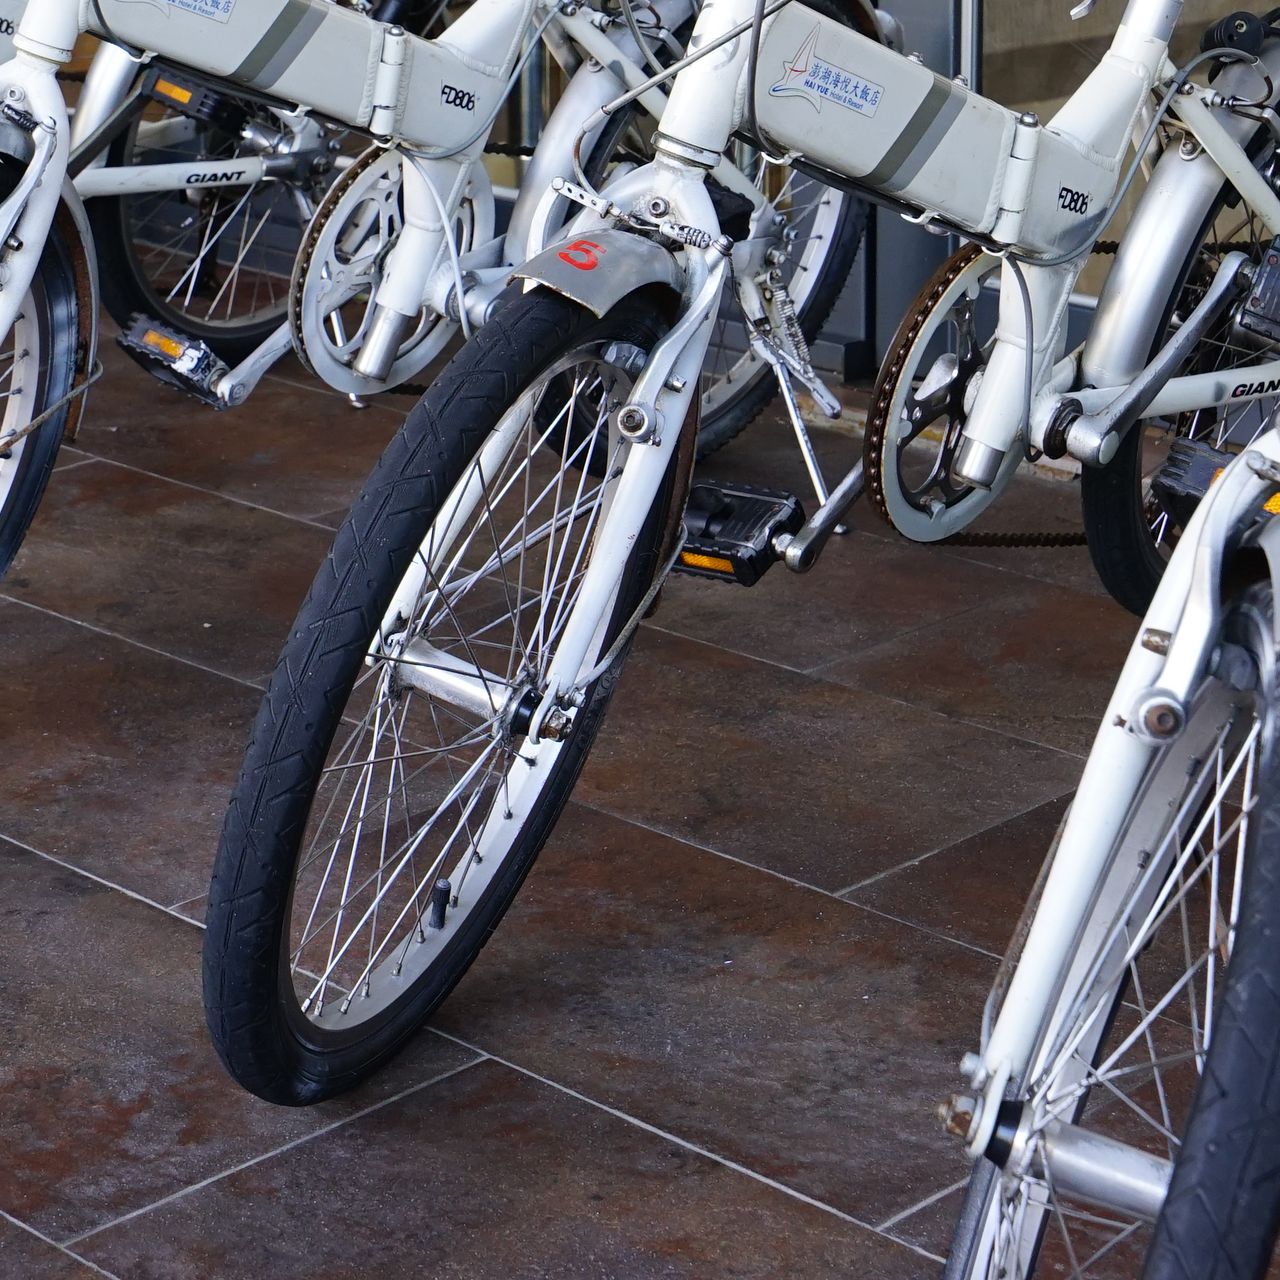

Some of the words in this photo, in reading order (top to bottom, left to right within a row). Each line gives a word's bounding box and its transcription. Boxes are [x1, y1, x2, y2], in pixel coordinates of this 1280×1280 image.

[441, 84, 475, 111] FD806
[803, 79, 816, 90] HAI
[816, 84, 829, 96] YUE
[829, 90, 843, 102] Hotel
[846, 97, 864, 111] Resort
[185, 170, 246, 184] GIANT
[1058, 186, 1090, 216] FD806
[557, 239, 607, 271] 5
